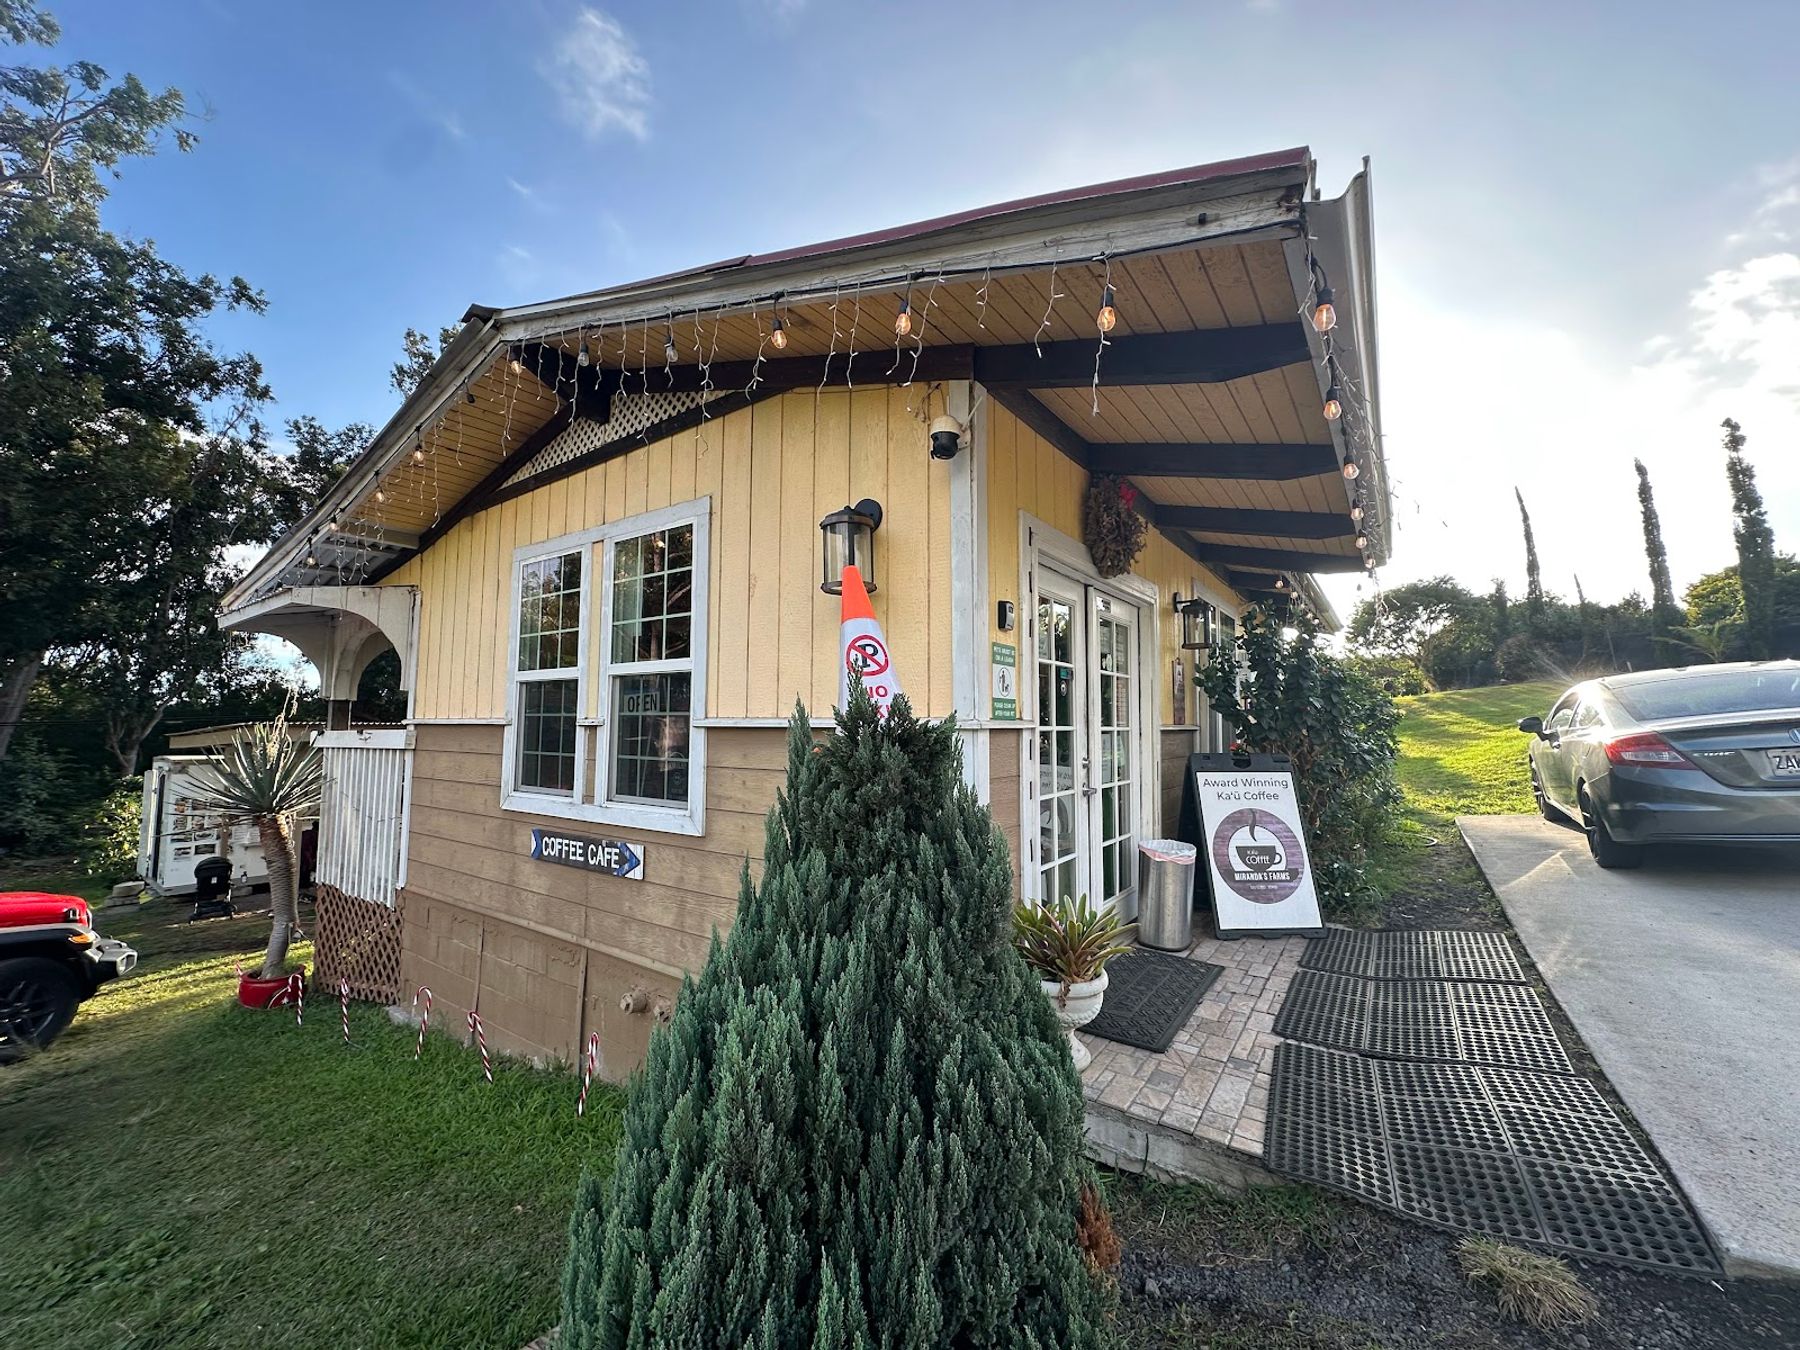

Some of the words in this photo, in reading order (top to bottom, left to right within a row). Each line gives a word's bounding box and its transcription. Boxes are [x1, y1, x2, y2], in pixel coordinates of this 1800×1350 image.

[628, 693, 657, 713] OPEN
[1203, 778, 1238, 787] Award
[1241, 777, 1288, 789] Winning
[1243, 790, 1280, 800] Coffee
[542, 836, 584, 862] COFFEE
[1234, 872, 1268, 881] MIRANDA'S
[1269, 872, 1291, 881] FARMS
